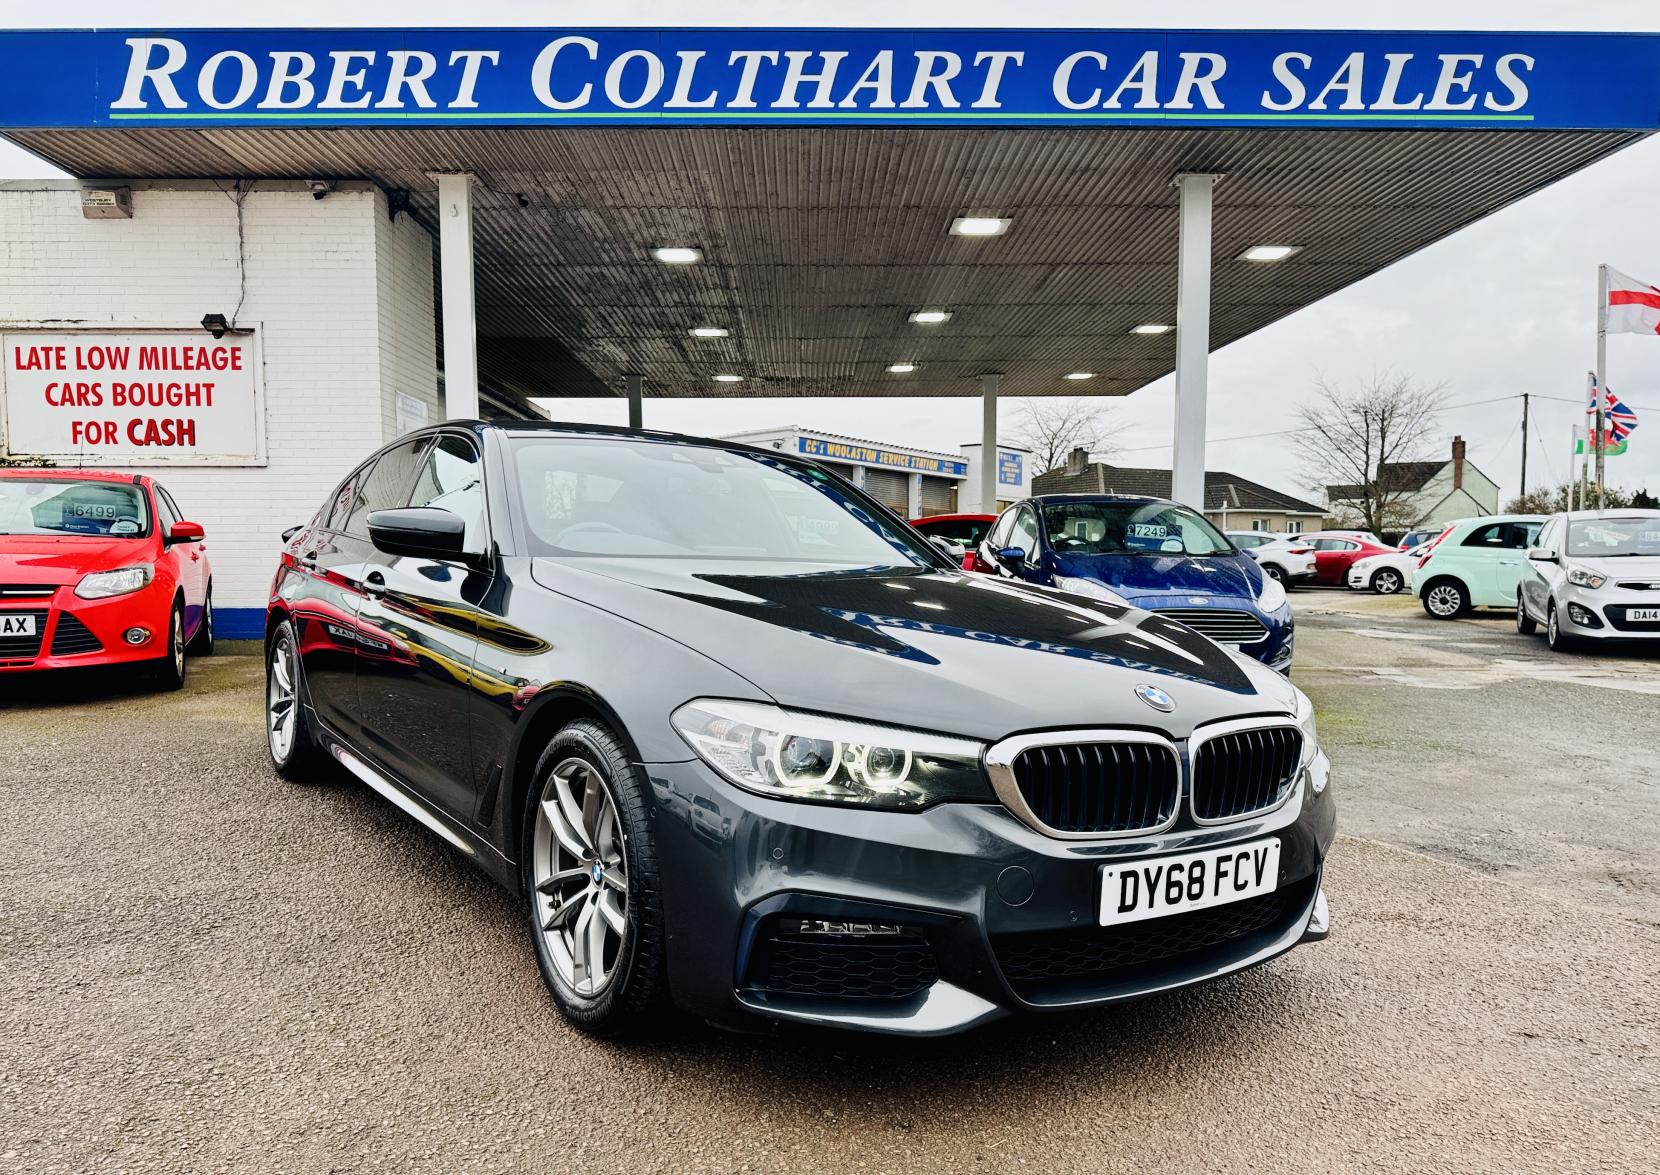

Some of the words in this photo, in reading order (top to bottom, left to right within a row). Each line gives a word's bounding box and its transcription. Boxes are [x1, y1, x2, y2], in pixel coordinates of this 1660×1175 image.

[110, 37, 500, 111] ROBERT
[531, 35, 1025, 111] COLTHART
[1052, 50, 1227, 111] CAR
[1261, 51, 1536, 113] SALES
[14, 346, 67, 371] LATE
[75, 346, 130, 371] LOW
[138, 346, 242, 371] MILEAGE
[44, 382, 104, 407] CARS
[112, 382, 215, 407] BOUGHT
[71, 420, 119, 445] FOR
[126, 418, 196, 446] CASH
[827, 443, 876, 462] WOOLASTON
[879, 452, 909, 468] SERVICE
[911, 457, 938, 472] STATION
[1127, 523, 1166, 537] £7249
[0, 617, 27, 633] AX
[1633, 610, 1658, 620] DA14
[1117, 859, 1206, 914] DY68
[1213, 847, 1268, 897] FCV
